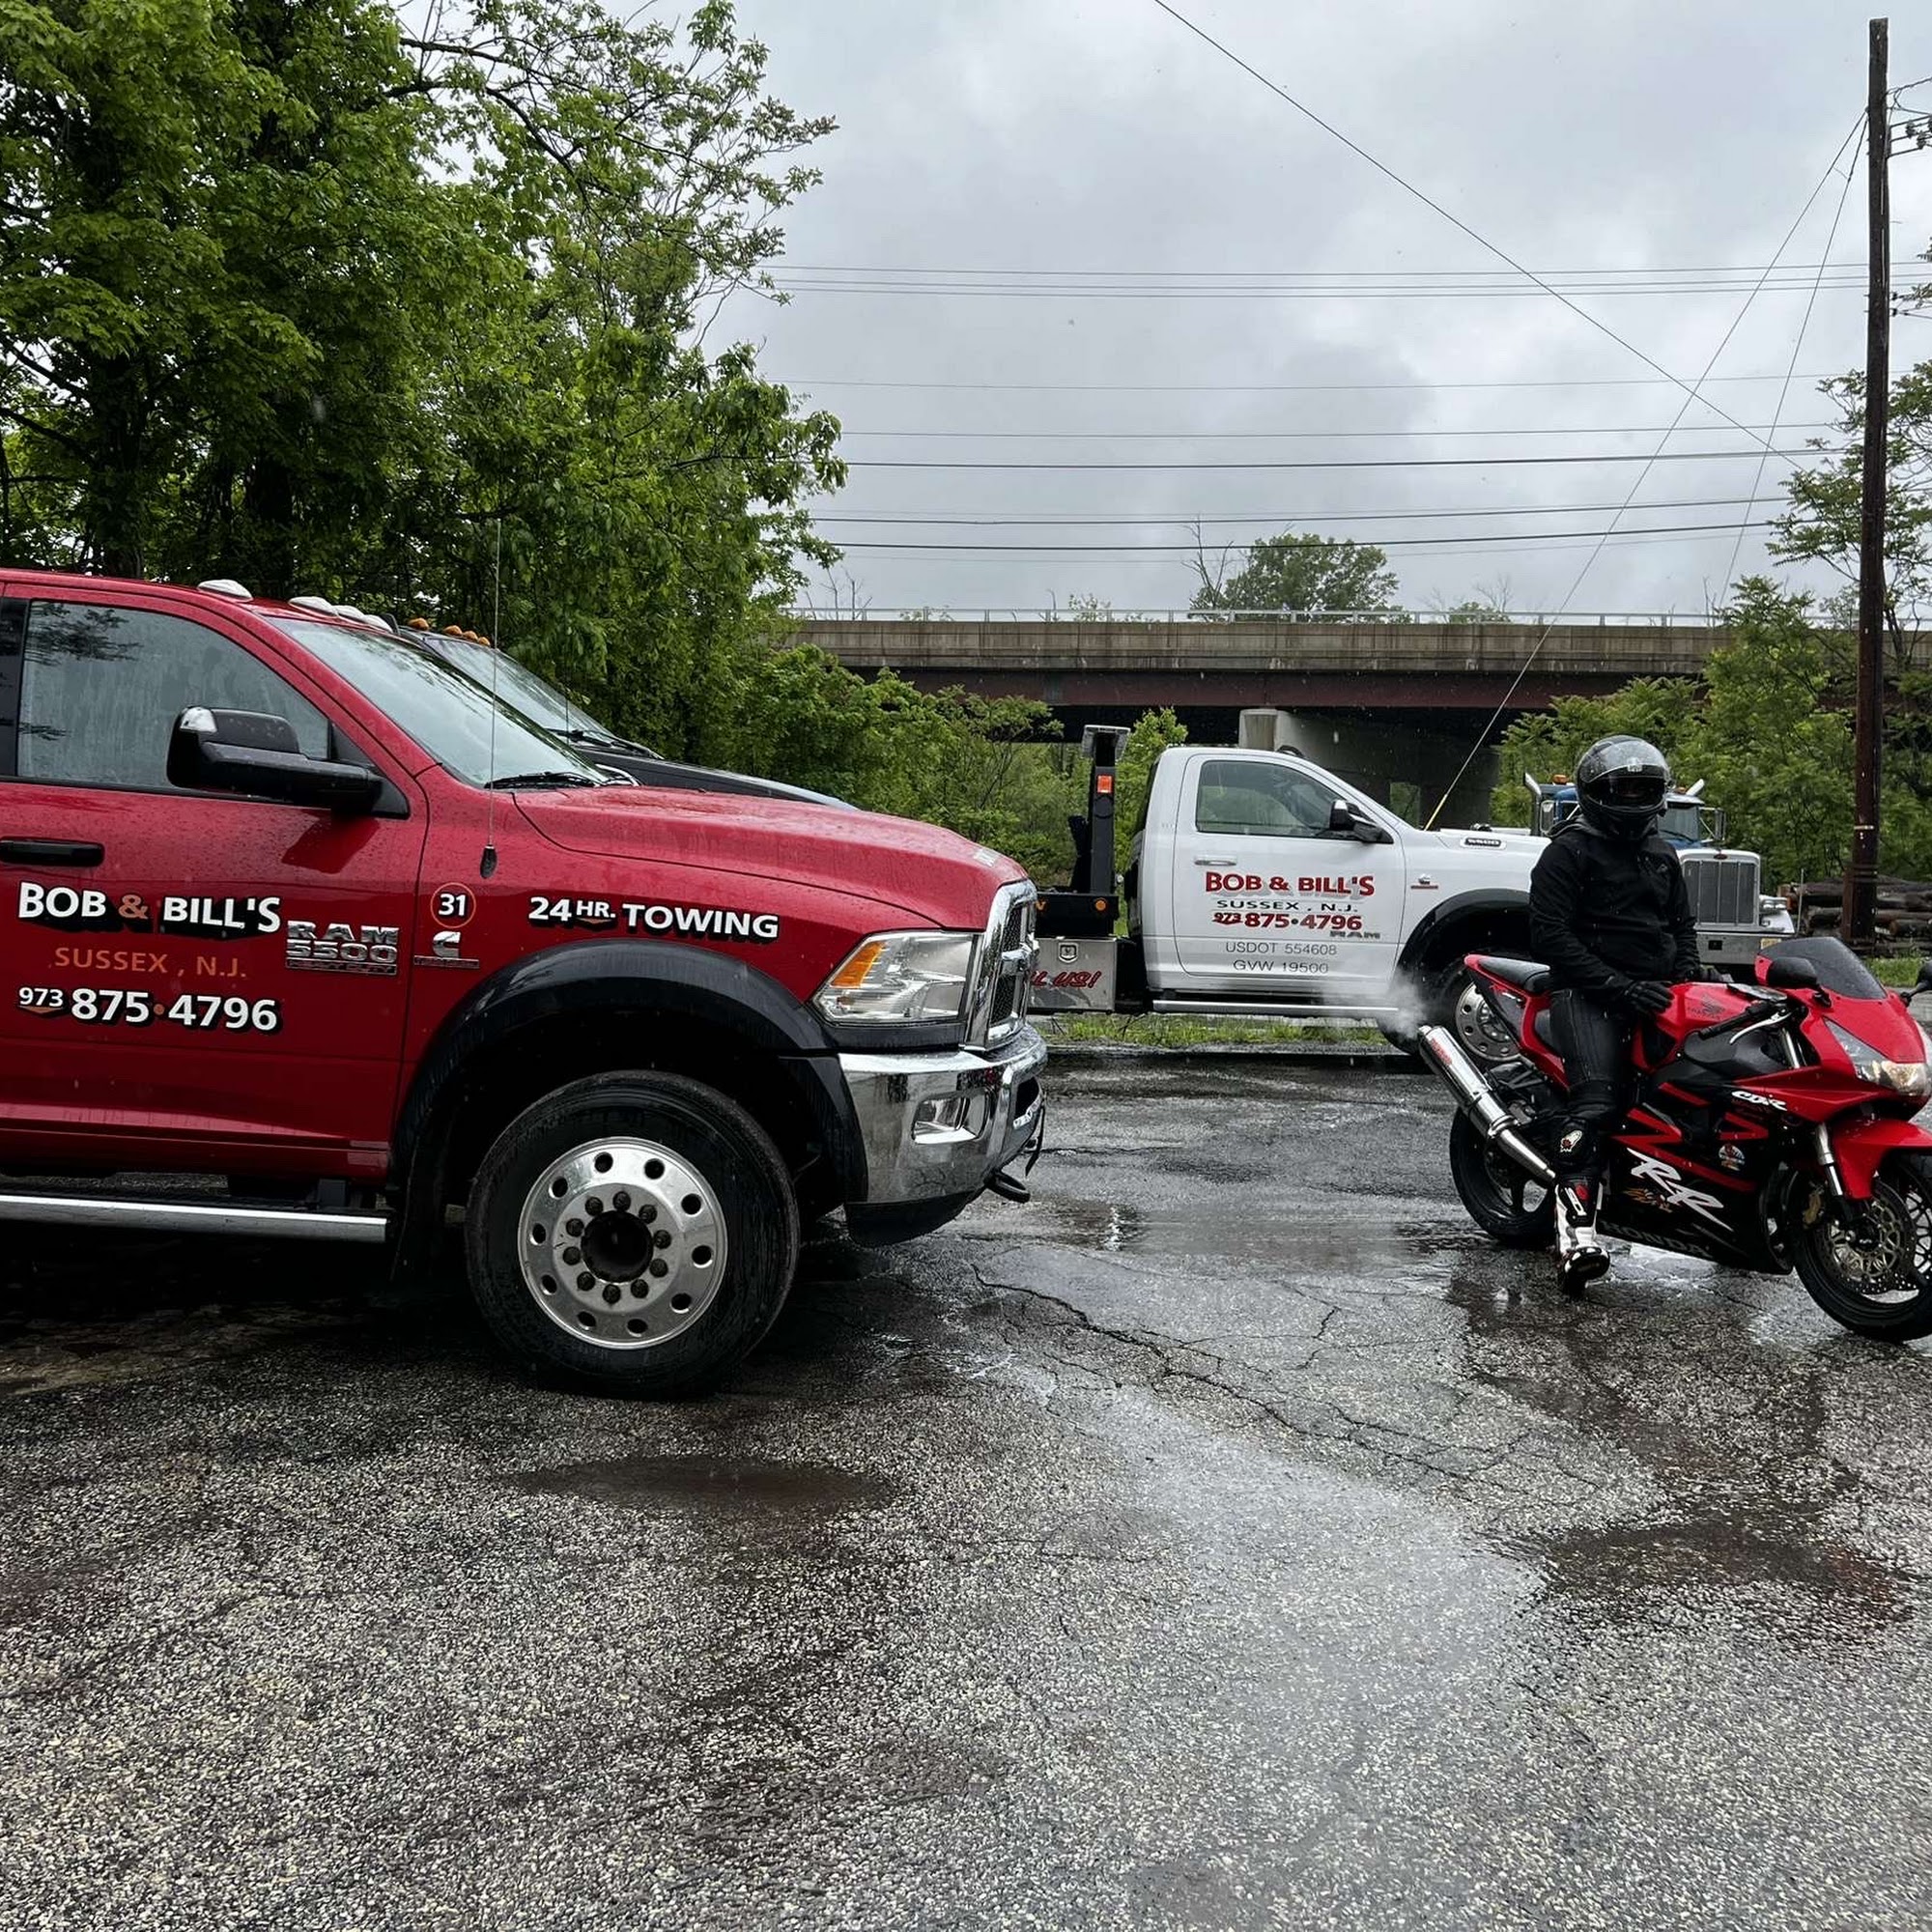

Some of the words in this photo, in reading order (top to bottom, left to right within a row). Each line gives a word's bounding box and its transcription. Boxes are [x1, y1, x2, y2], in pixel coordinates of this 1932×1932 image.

[1206, 871, 1262, 893] BOB
[1269, 876, 1290, 892] &
[1298, 875, 1376, 896] BILL'S
[18, 881, 106, 919] BOB
[119, 895, 149, 920] &
[163, 896, 281, 933] BILL'S
[438, 893, 467, 917] 31
[528, 896, 573, 922] 24
[622, 903, 780, 938] TOWING
[287, 920, 399, 945] RAM
[286, 939, 398, 963] 5500
[1226, 942, 1277, 954] USDOT
[1285, 944, 1337, 955] 554608
[196, 956, 247, 978] N.J.
[1233, 960, 1273, 972] GVW
[1283, 962, 1328, 974] 19500
[18, 986, 64, 1008] 973
